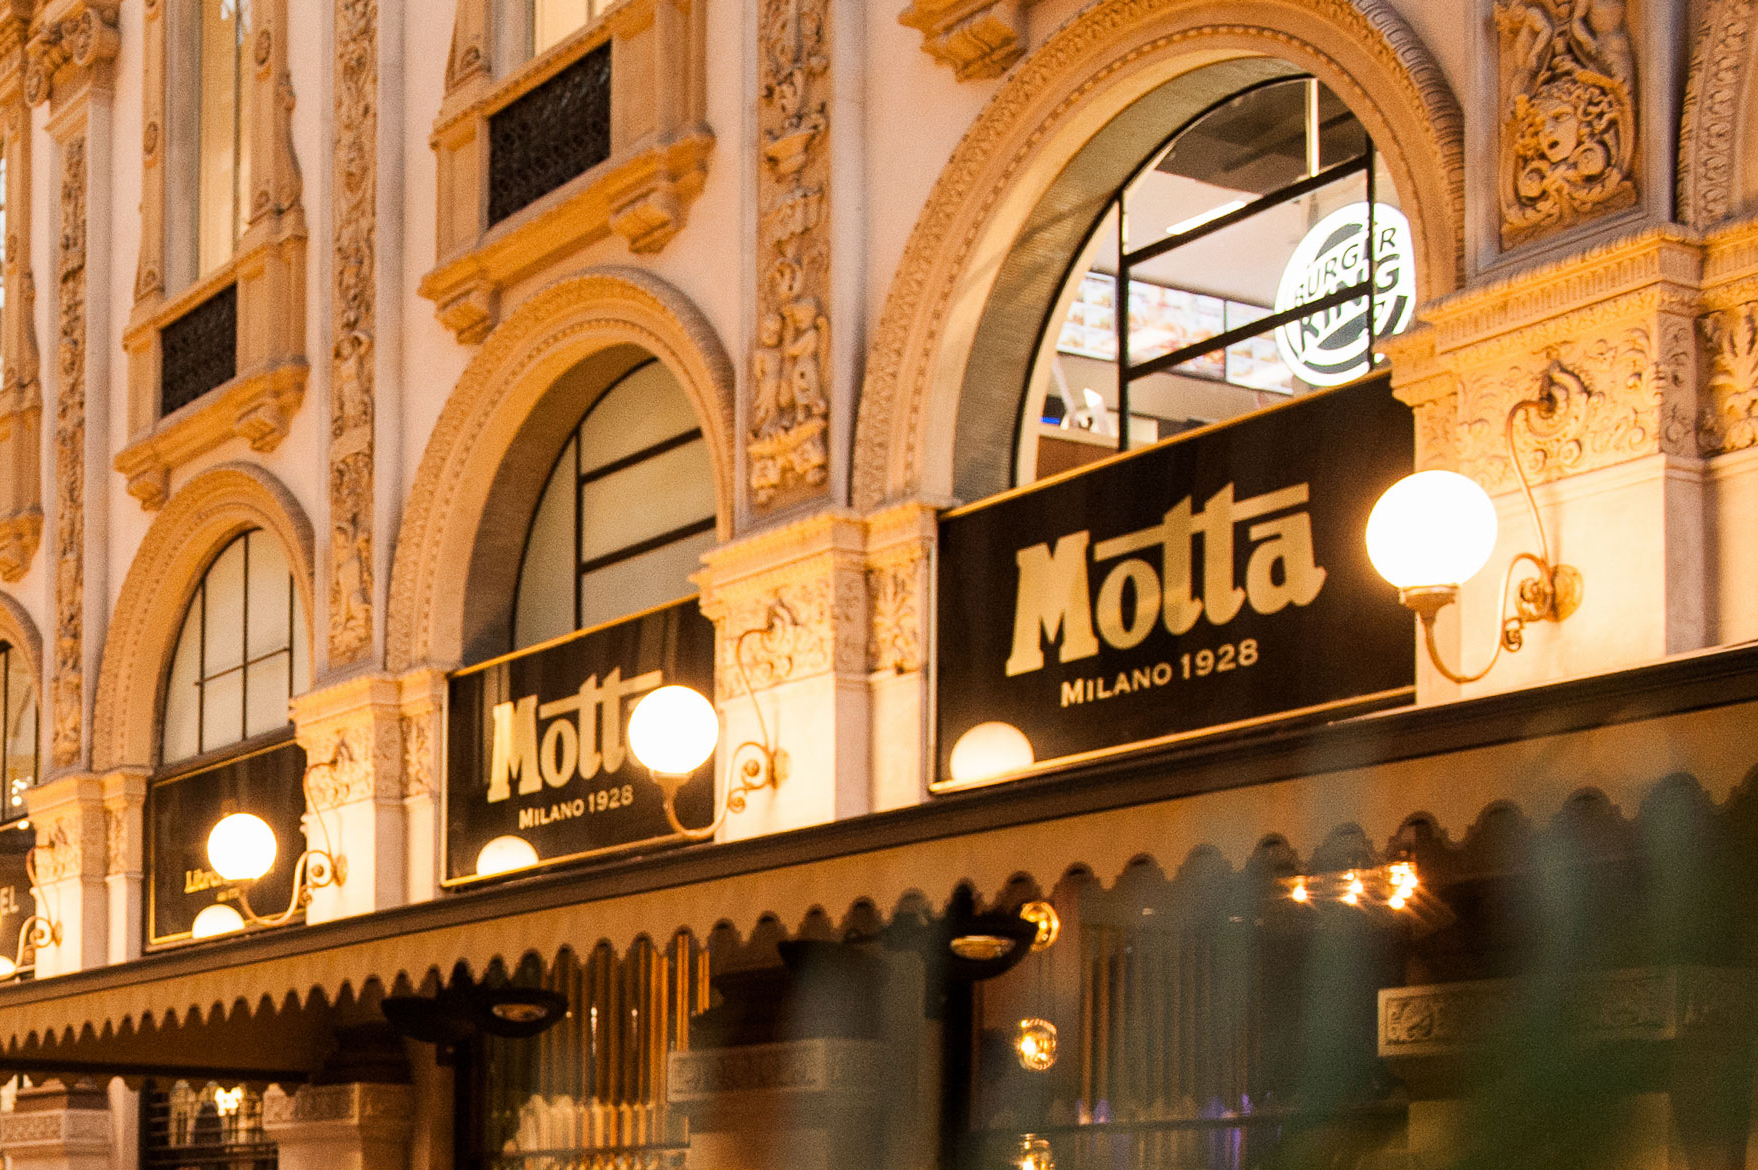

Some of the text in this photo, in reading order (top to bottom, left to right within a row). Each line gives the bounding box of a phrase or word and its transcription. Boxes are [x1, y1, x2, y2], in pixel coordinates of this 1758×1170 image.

[1294, 227, 1396, 308] BURGR
[1005, 482, 1328, 677] Motta
[1060, 637, 1259, 708] MILANO 1928
[487, 666, 663, 804] Mott
[518, 784, 635, 830] MILANO 1928
